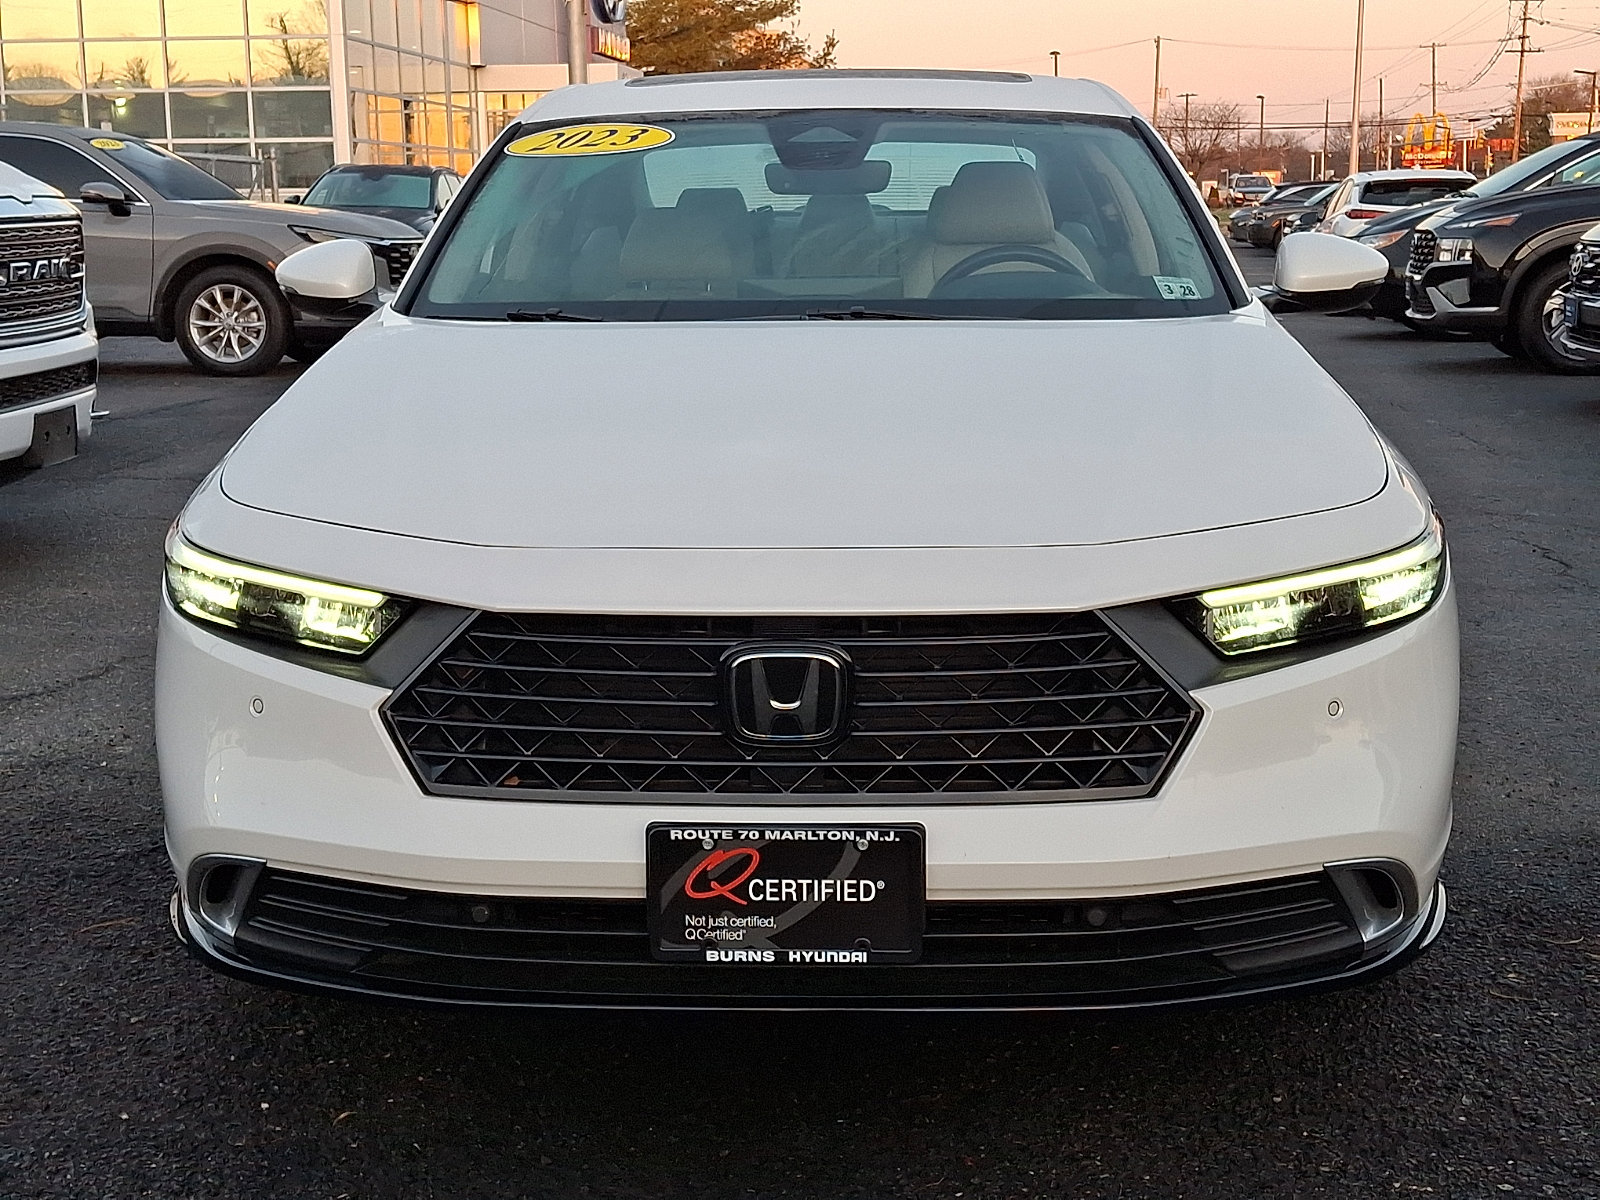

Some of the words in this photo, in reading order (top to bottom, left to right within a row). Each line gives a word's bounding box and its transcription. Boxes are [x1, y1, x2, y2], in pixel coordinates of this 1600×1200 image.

[525, 129, 649, 152] 2023
[1164, 284, 1174, 295] 3
[1180, 285, 1196, 297] 28
[670, 829, 733, 840] ROUTE
[738, 830, 759, 840] 70
[764, 830, 860, 842] MARLTON,
[866, 831, 900, 842] N.J.
[685, 915, 706, 927] Not
[707, 915, 729, 929] just
[729, 916, 777, 929] certified,
[706, 951, 775, 962] BURNS
[788, 951, 868, 963] HYUNDAI
